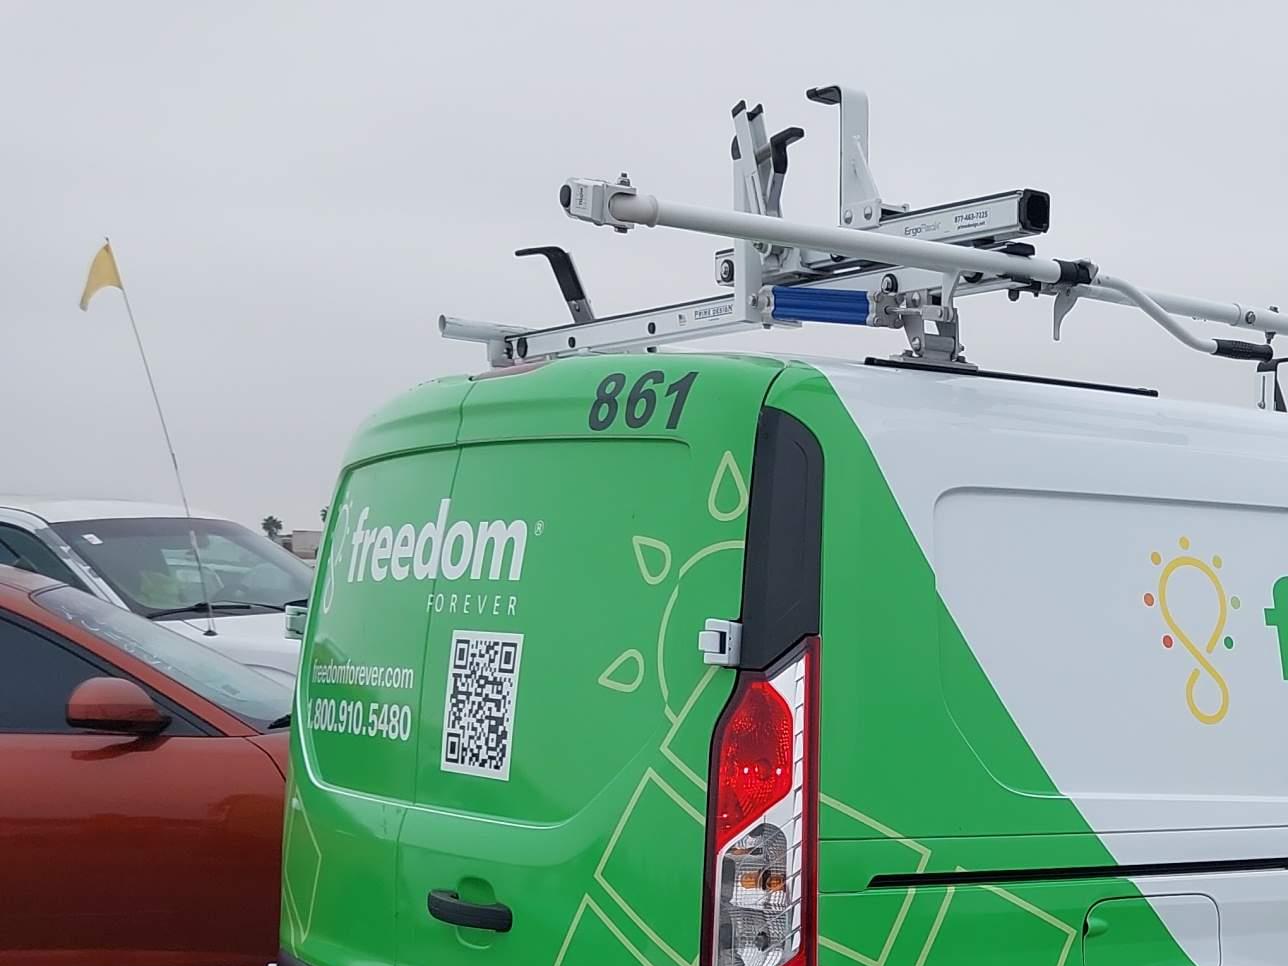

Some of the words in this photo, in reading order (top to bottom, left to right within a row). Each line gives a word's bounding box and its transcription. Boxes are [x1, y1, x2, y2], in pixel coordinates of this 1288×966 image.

[588, 370, 699, 431] 861
[347, 498, 528, 583] freedom
[426, 593, 518, 616] FOREVER
[312, 658, 414, 688] freedomforever.com
[307, 698, 411, 741] 1.800.910.5480
